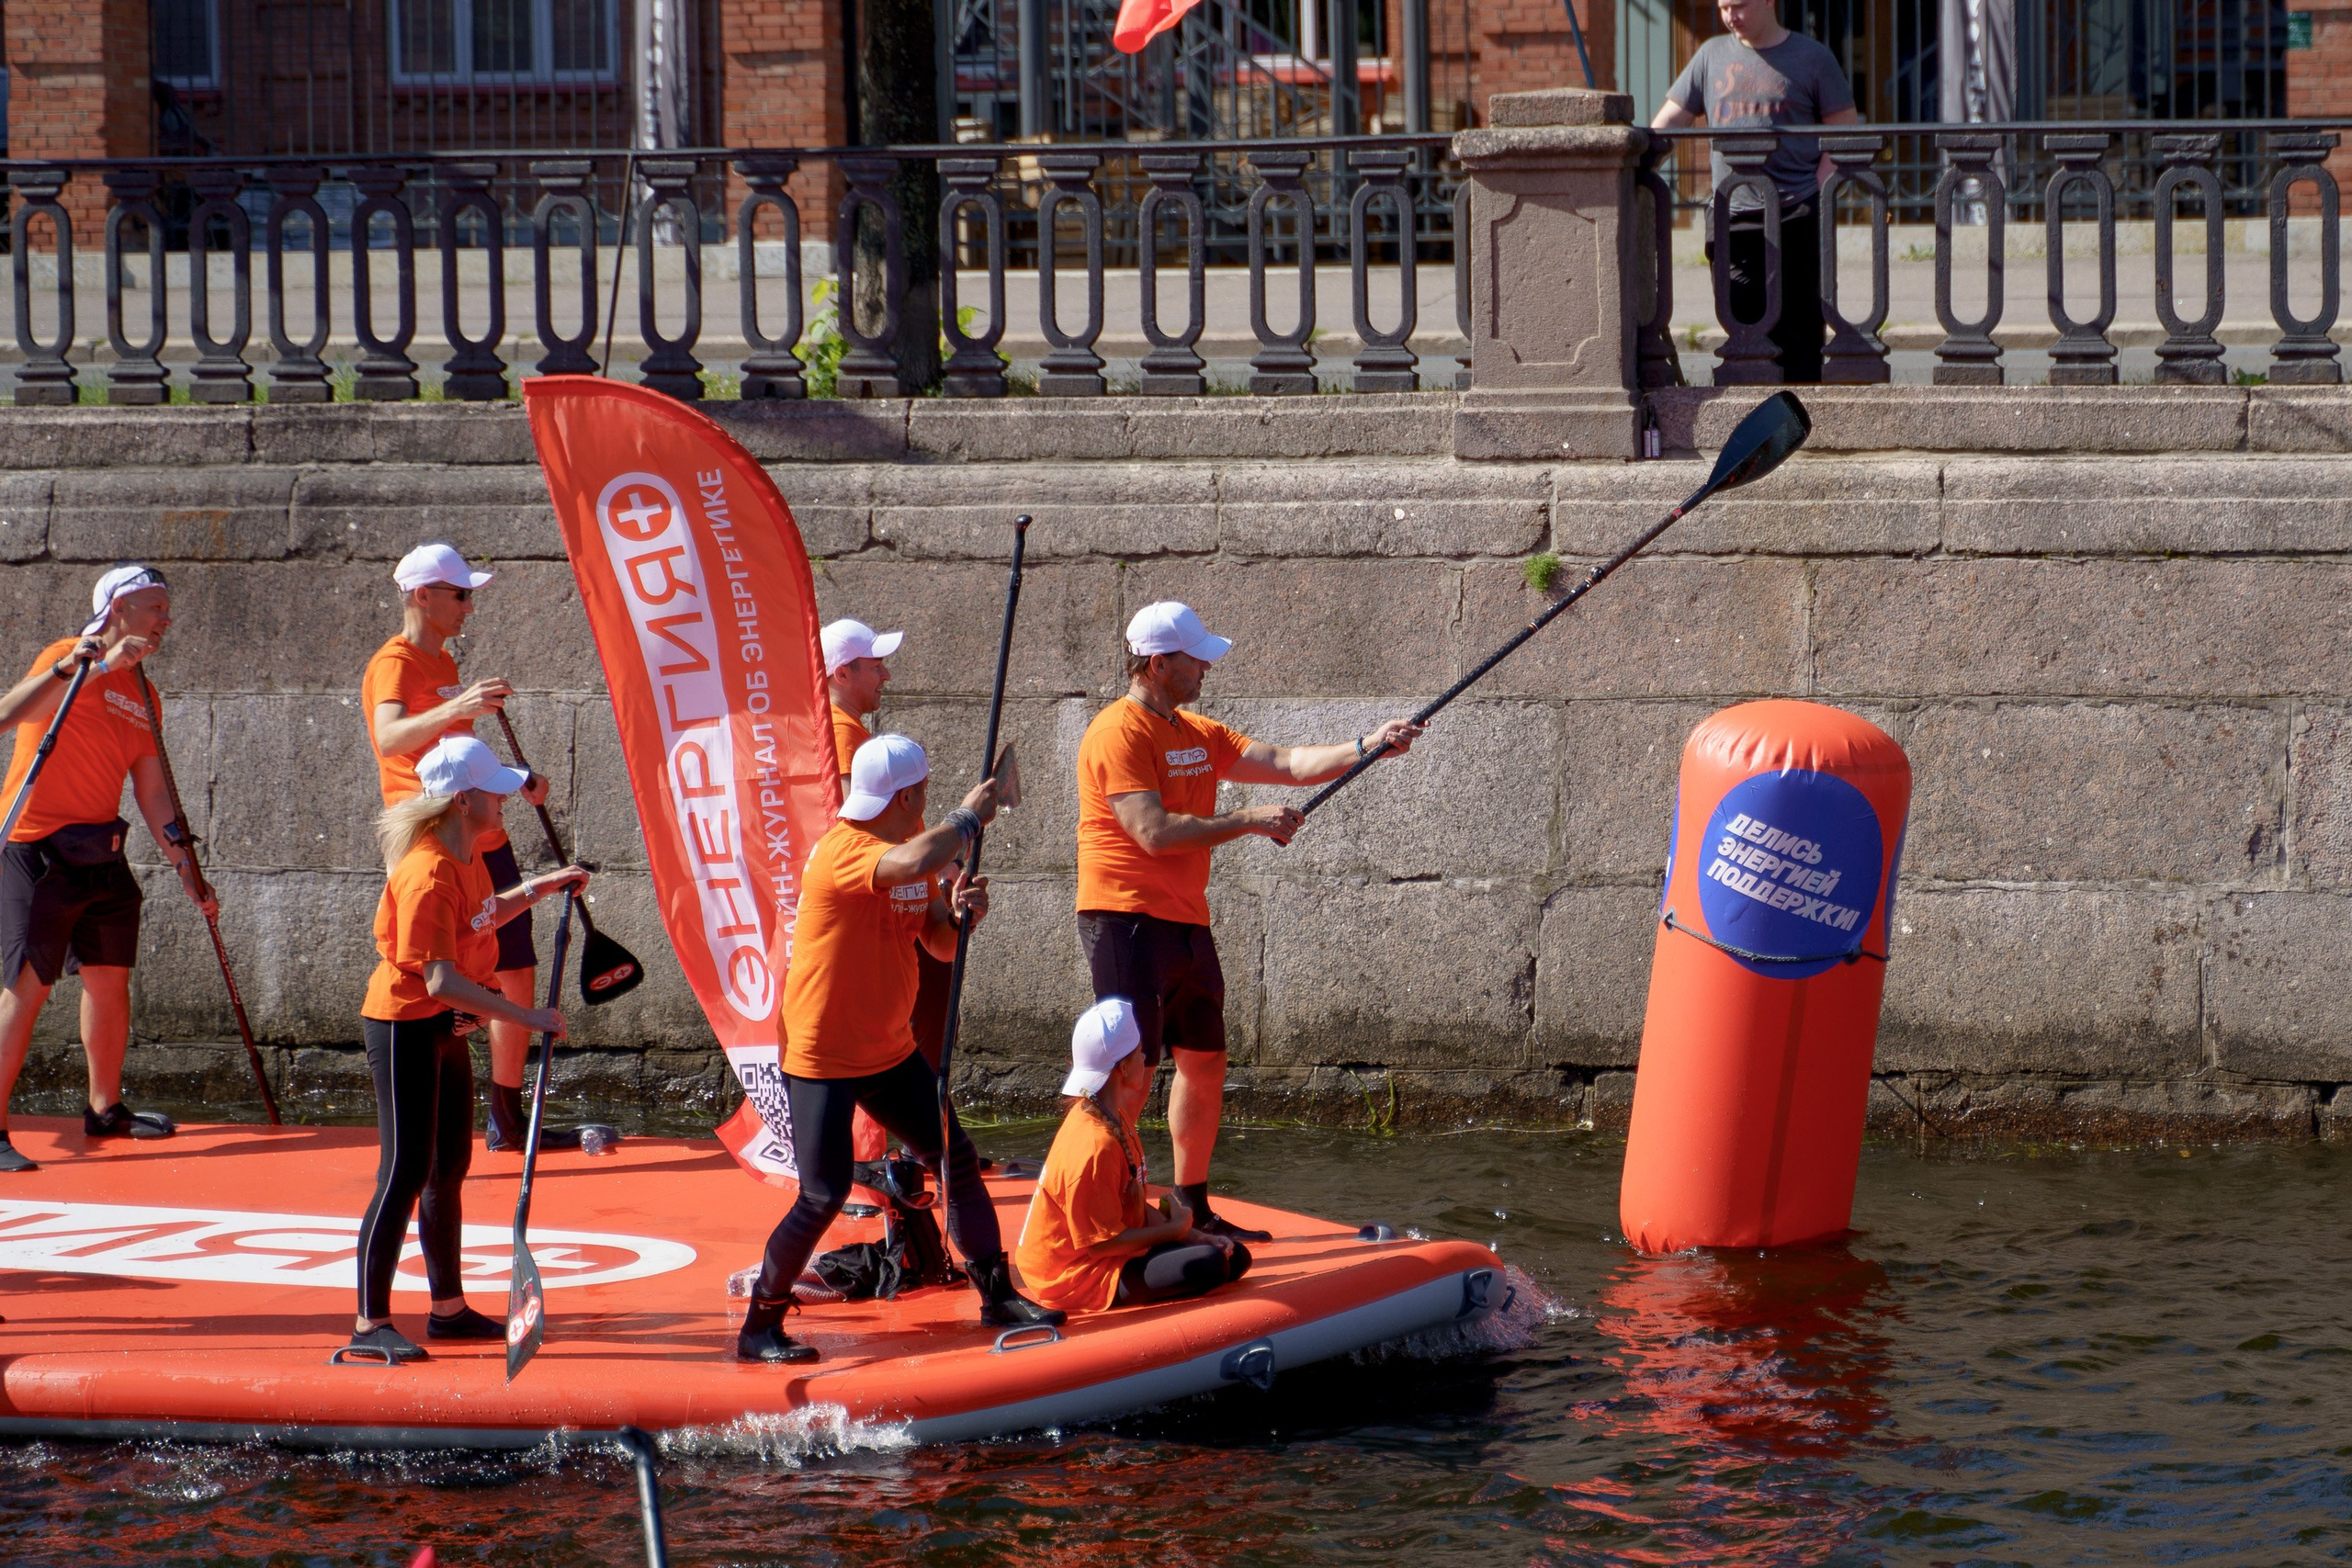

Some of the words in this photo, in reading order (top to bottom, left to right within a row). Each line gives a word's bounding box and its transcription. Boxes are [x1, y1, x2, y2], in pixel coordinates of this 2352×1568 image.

[696, 468, 763, 663] ЭНЕРГЕТИКЕ
[746, 671, 771, 715] ОБ
[624, 545, 770, 1009] ЭНЕРГИЯ
[1717, 837, 1842, 897] ЭНЕРГИЕЙ
[1725, 813, 1823, 865] ДЕЛИСЬ
